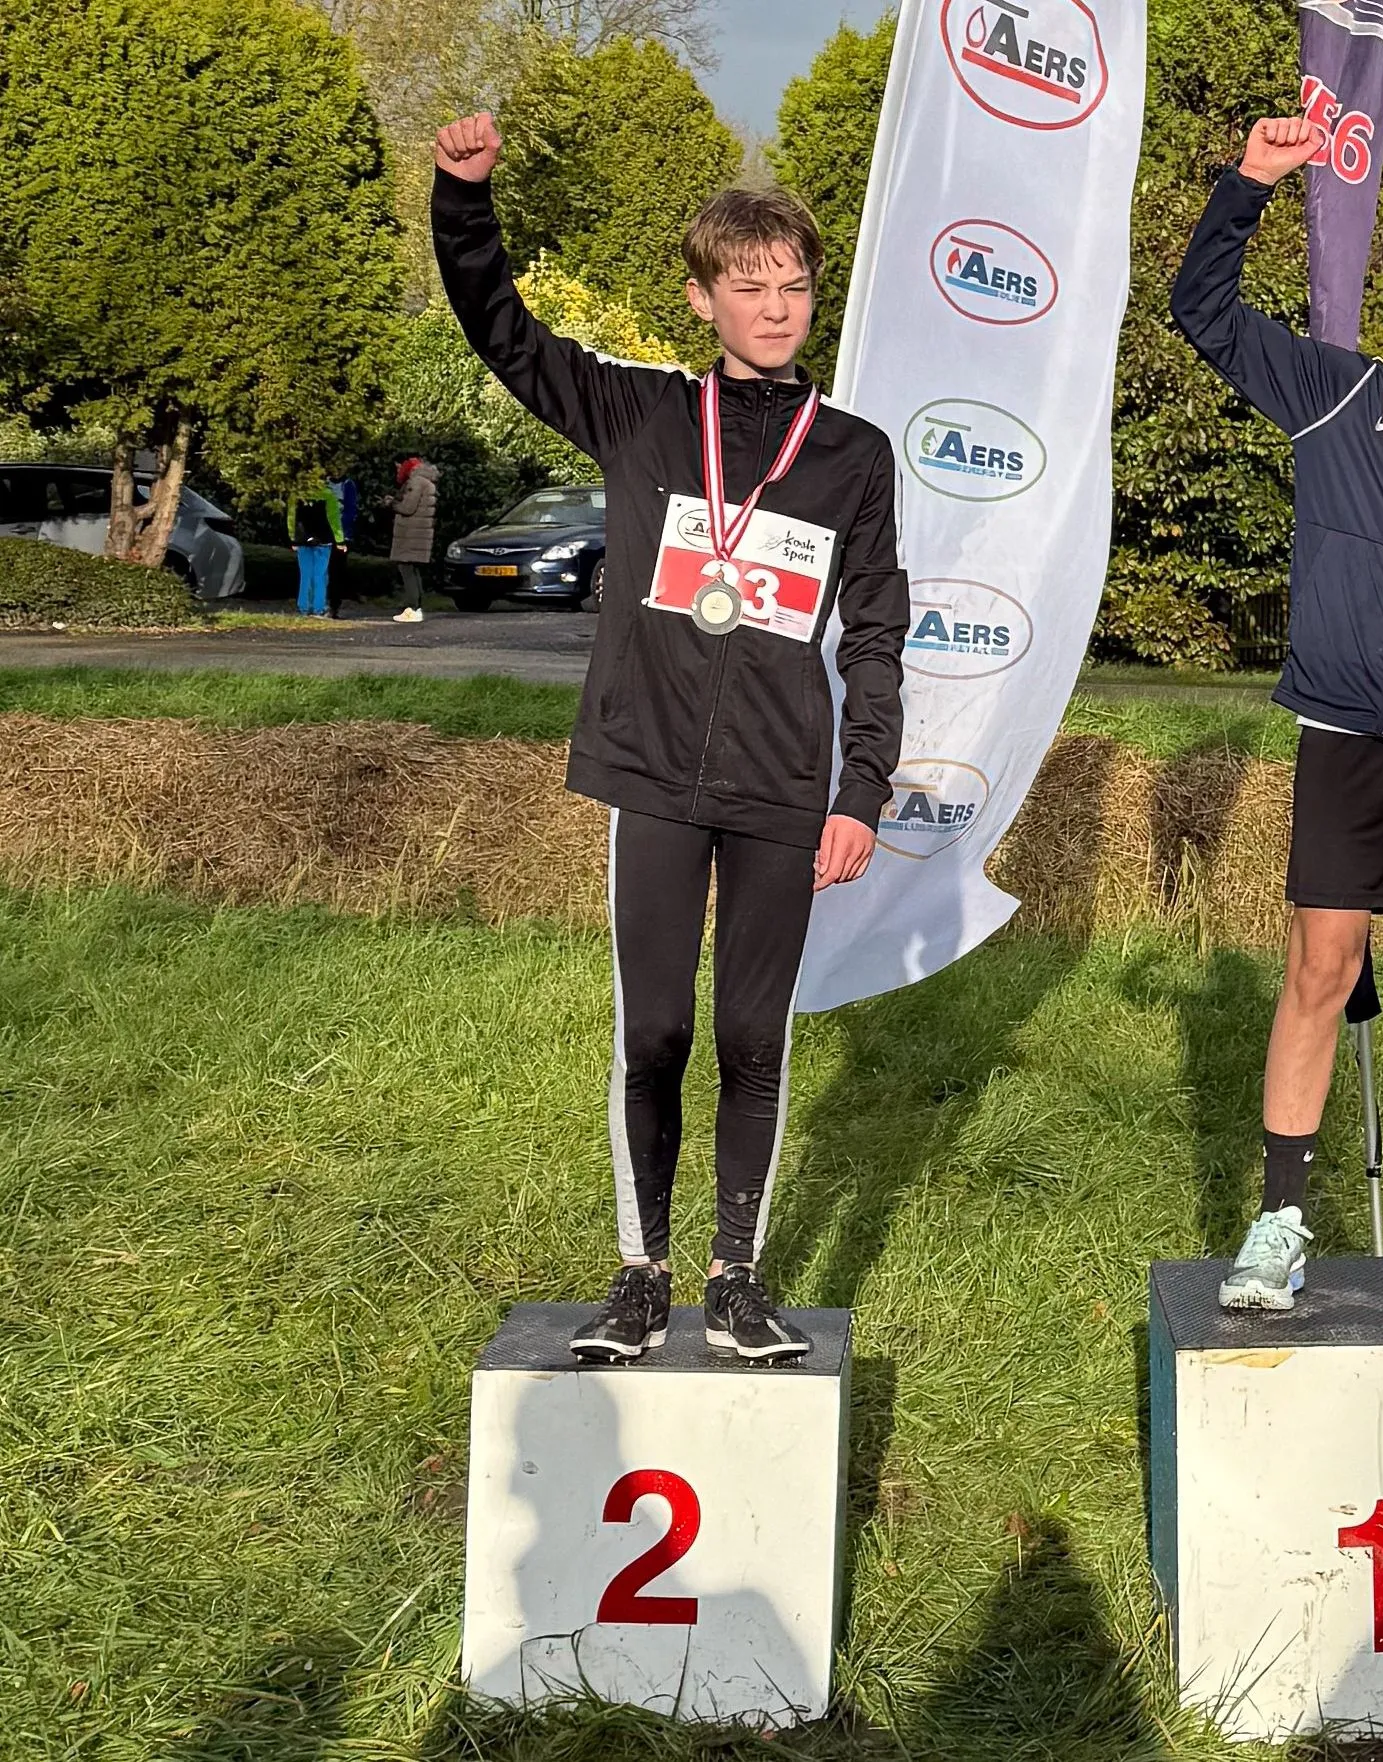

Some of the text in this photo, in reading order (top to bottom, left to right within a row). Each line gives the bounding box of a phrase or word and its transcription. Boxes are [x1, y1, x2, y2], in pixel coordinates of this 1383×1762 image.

[983, 13, 1086, 89] AERS
[960, 251, 1037, 297] AERS
[934, 430, 1023, 471] AERS
[913, 610, 1010, 646] AERS
[897, 792, 975, 824] AERS
[596, 1469, 700, 1625] 2
